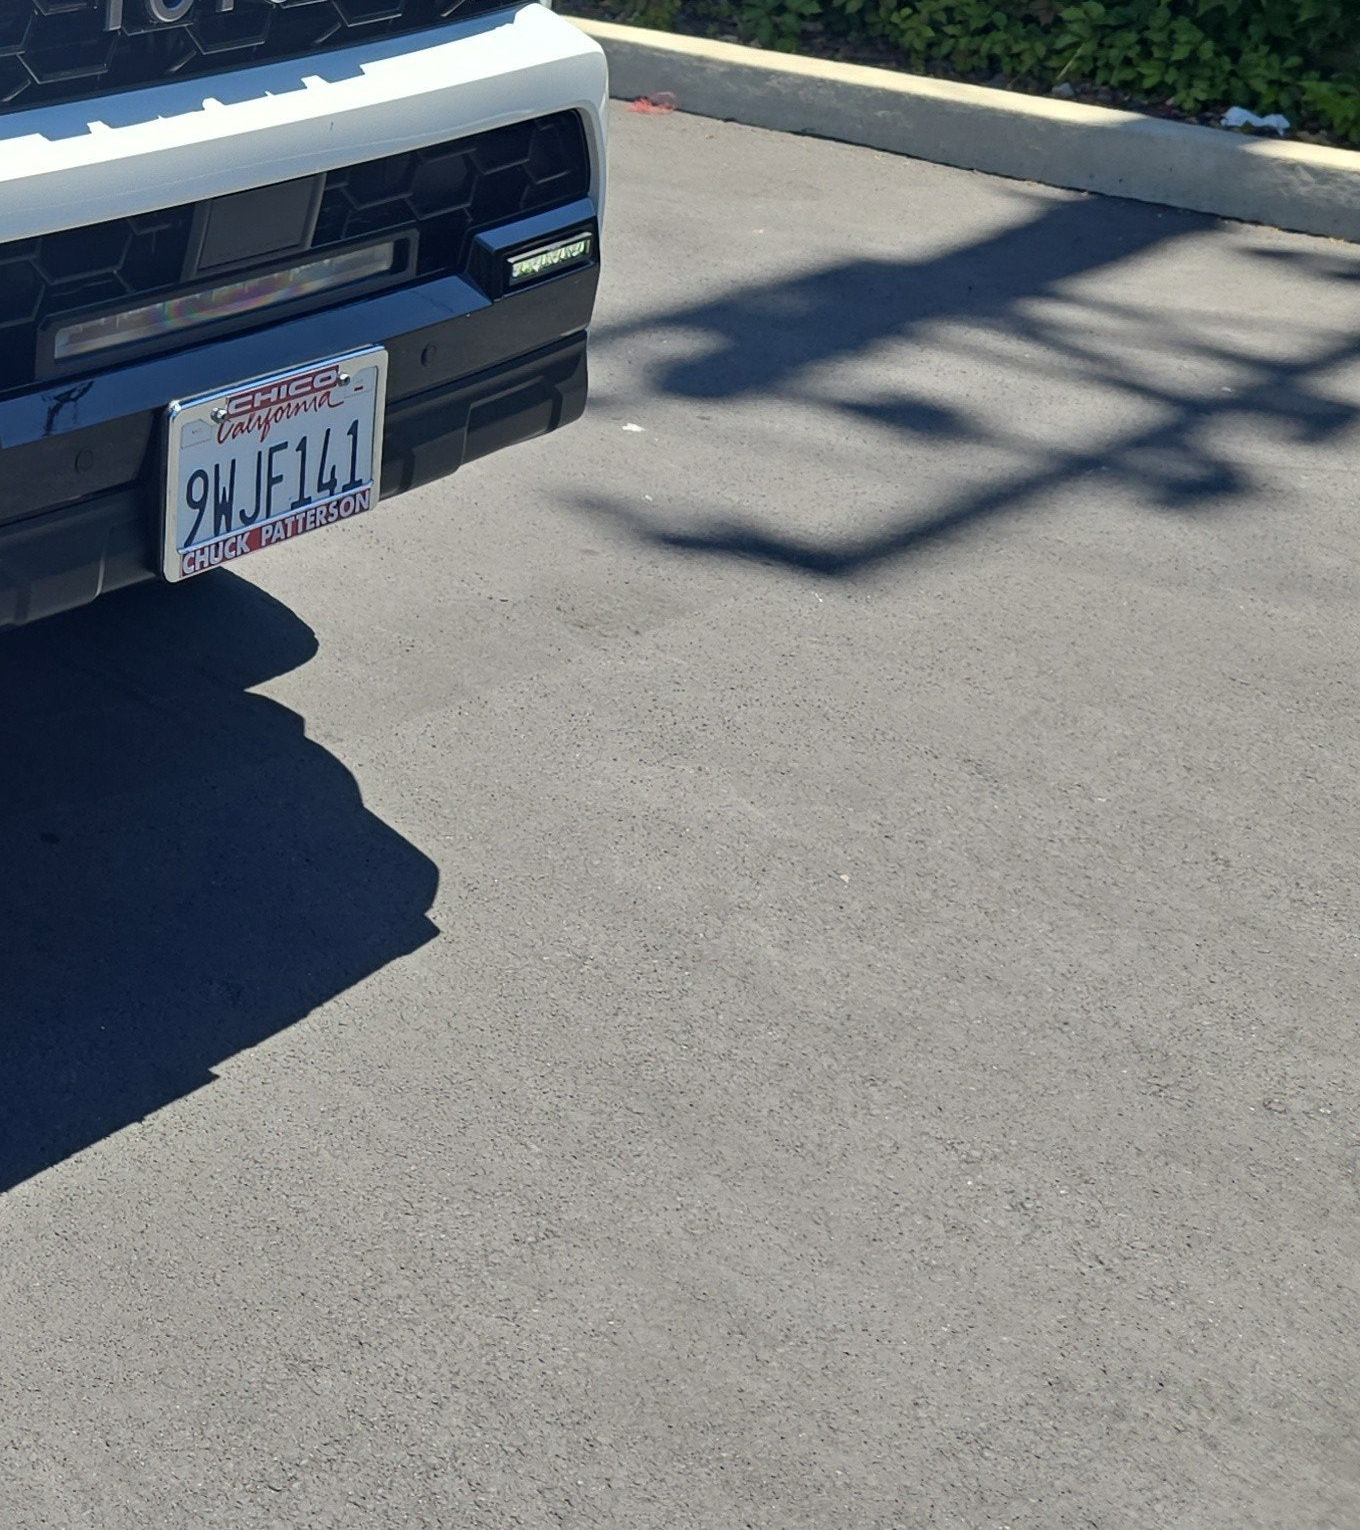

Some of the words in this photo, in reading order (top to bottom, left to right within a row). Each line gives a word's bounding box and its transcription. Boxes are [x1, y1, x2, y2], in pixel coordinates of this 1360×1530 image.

[217, 390, 344, 444] California
[228, 369, 339, 416] CHICO
[183, 419, 363, 549] 9WJF141
[183, 534, 251, 575] CHUCK
[261, 489, 371, 547] PATTERSON
